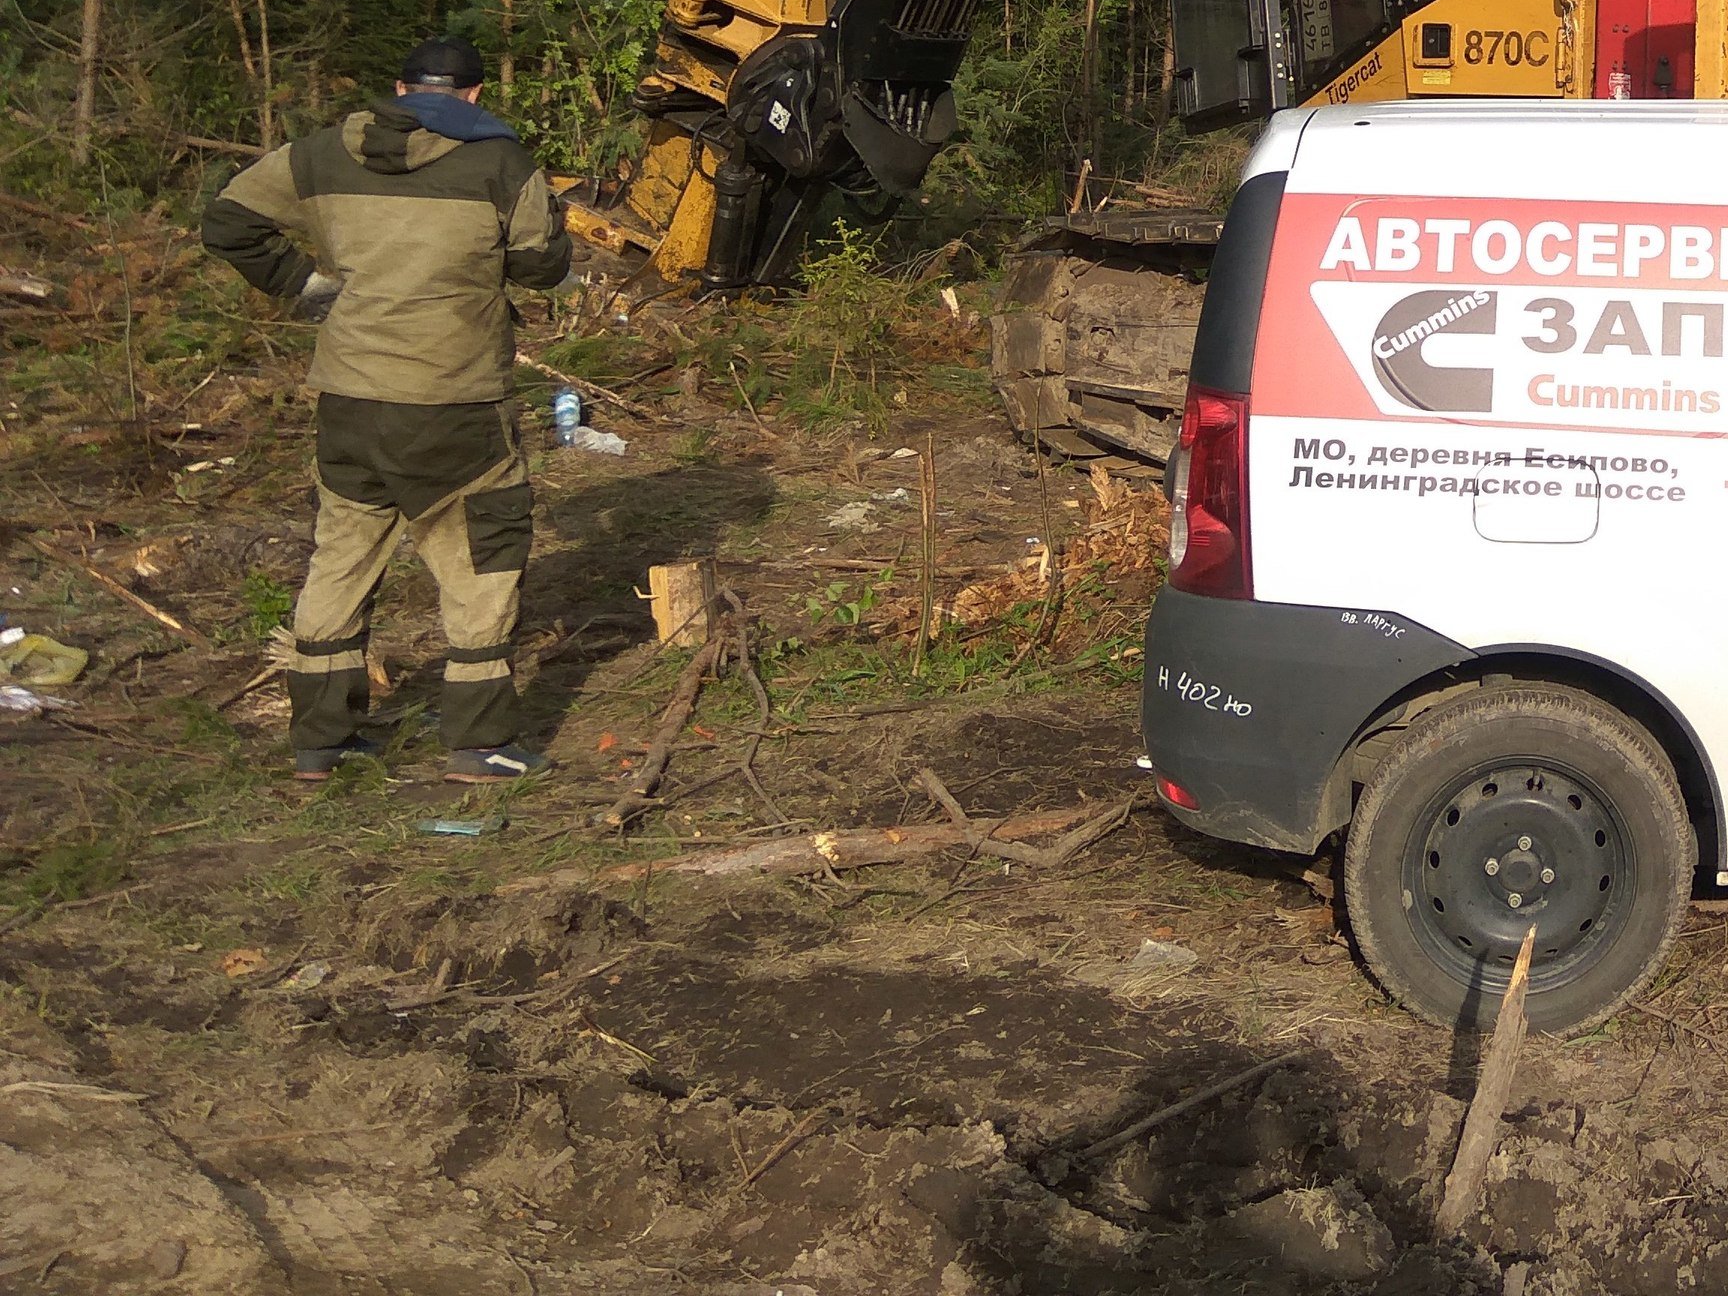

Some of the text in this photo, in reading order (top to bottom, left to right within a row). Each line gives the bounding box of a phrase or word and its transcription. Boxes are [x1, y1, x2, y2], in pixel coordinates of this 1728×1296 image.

[1464, 30, 1550, 67] 870C
[1324, 52, 1382, 106] Tigercat
[1373, 288, 1490, 360] Cummins
[1527, 374, 1721, 414] Cummins
[1293, 438, 1679, 479] МО, деревня Есипово,
[1289, 467, 1687, 503] Ленинградское шоссе
